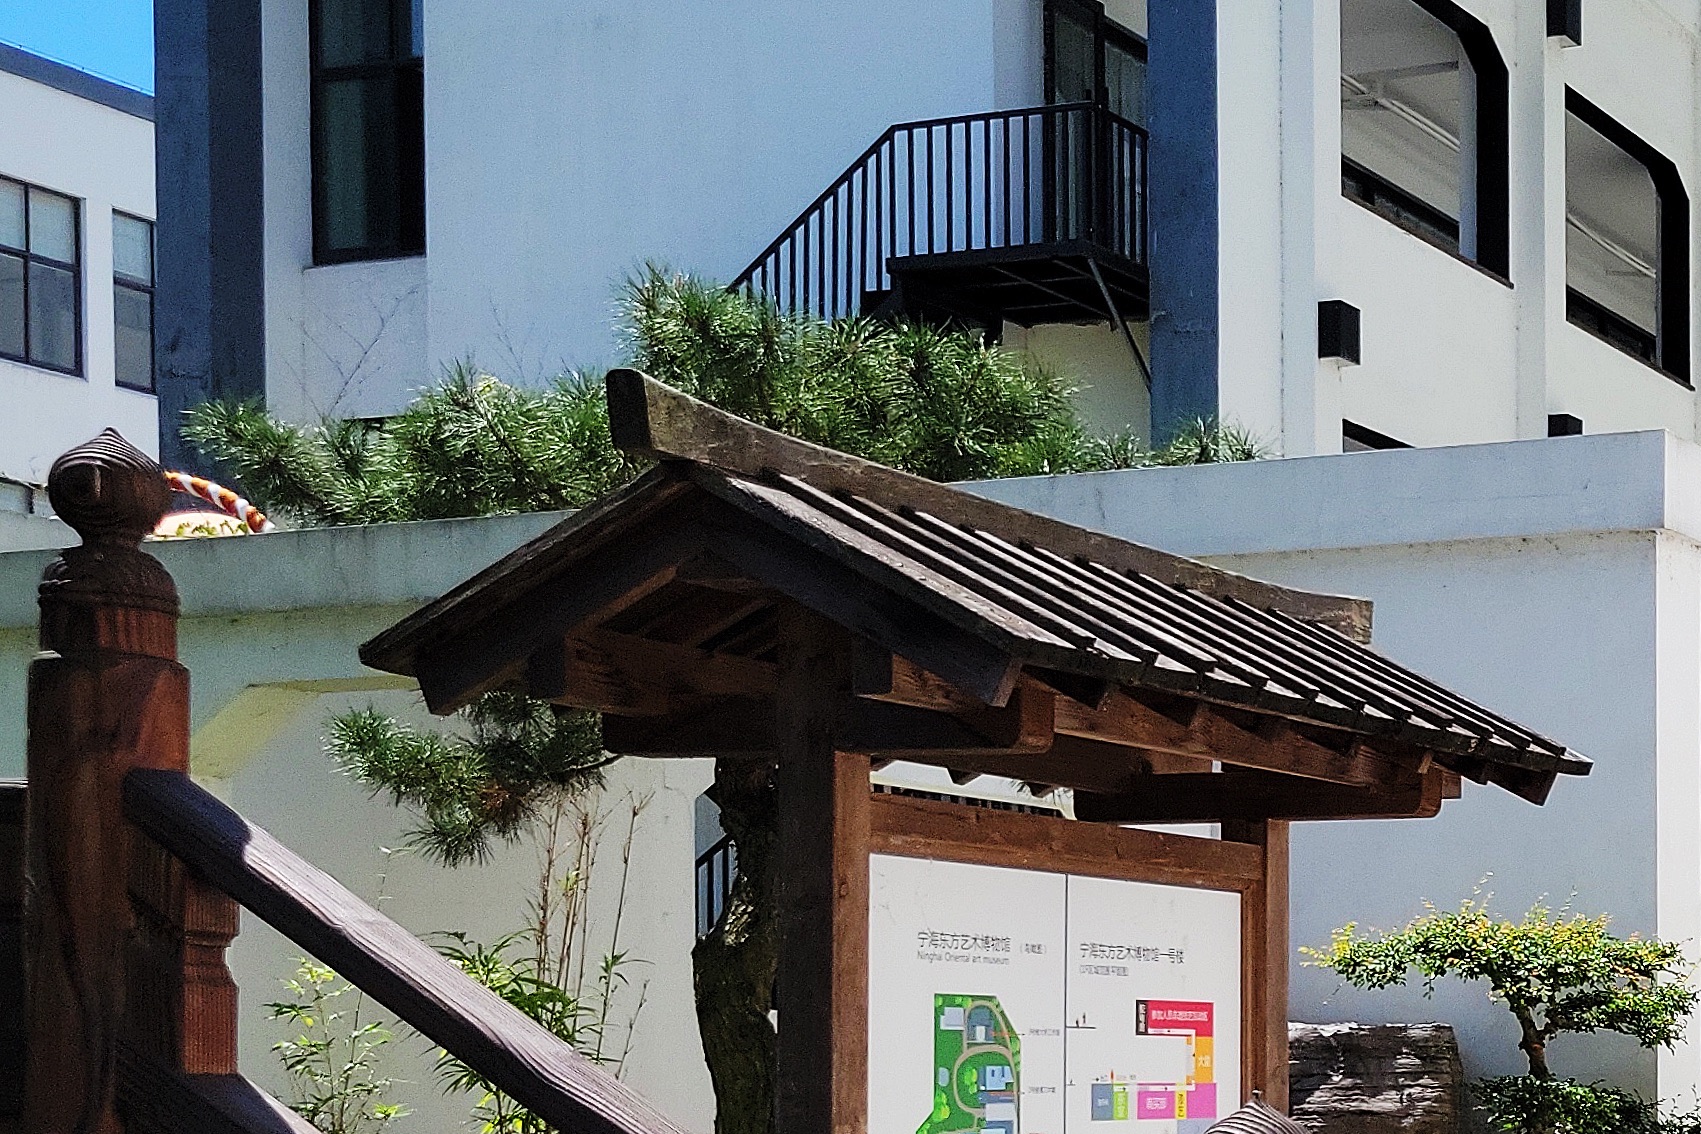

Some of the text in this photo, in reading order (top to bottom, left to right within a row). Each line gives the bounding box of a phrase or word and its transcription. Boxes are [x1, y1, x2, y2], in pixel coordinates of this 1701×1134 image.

[917, 931, 1011, 953] 宁海东方艺术博物馆
[1080, 943, 1185, 964] 宁海东方艺术博物馆一号楼
